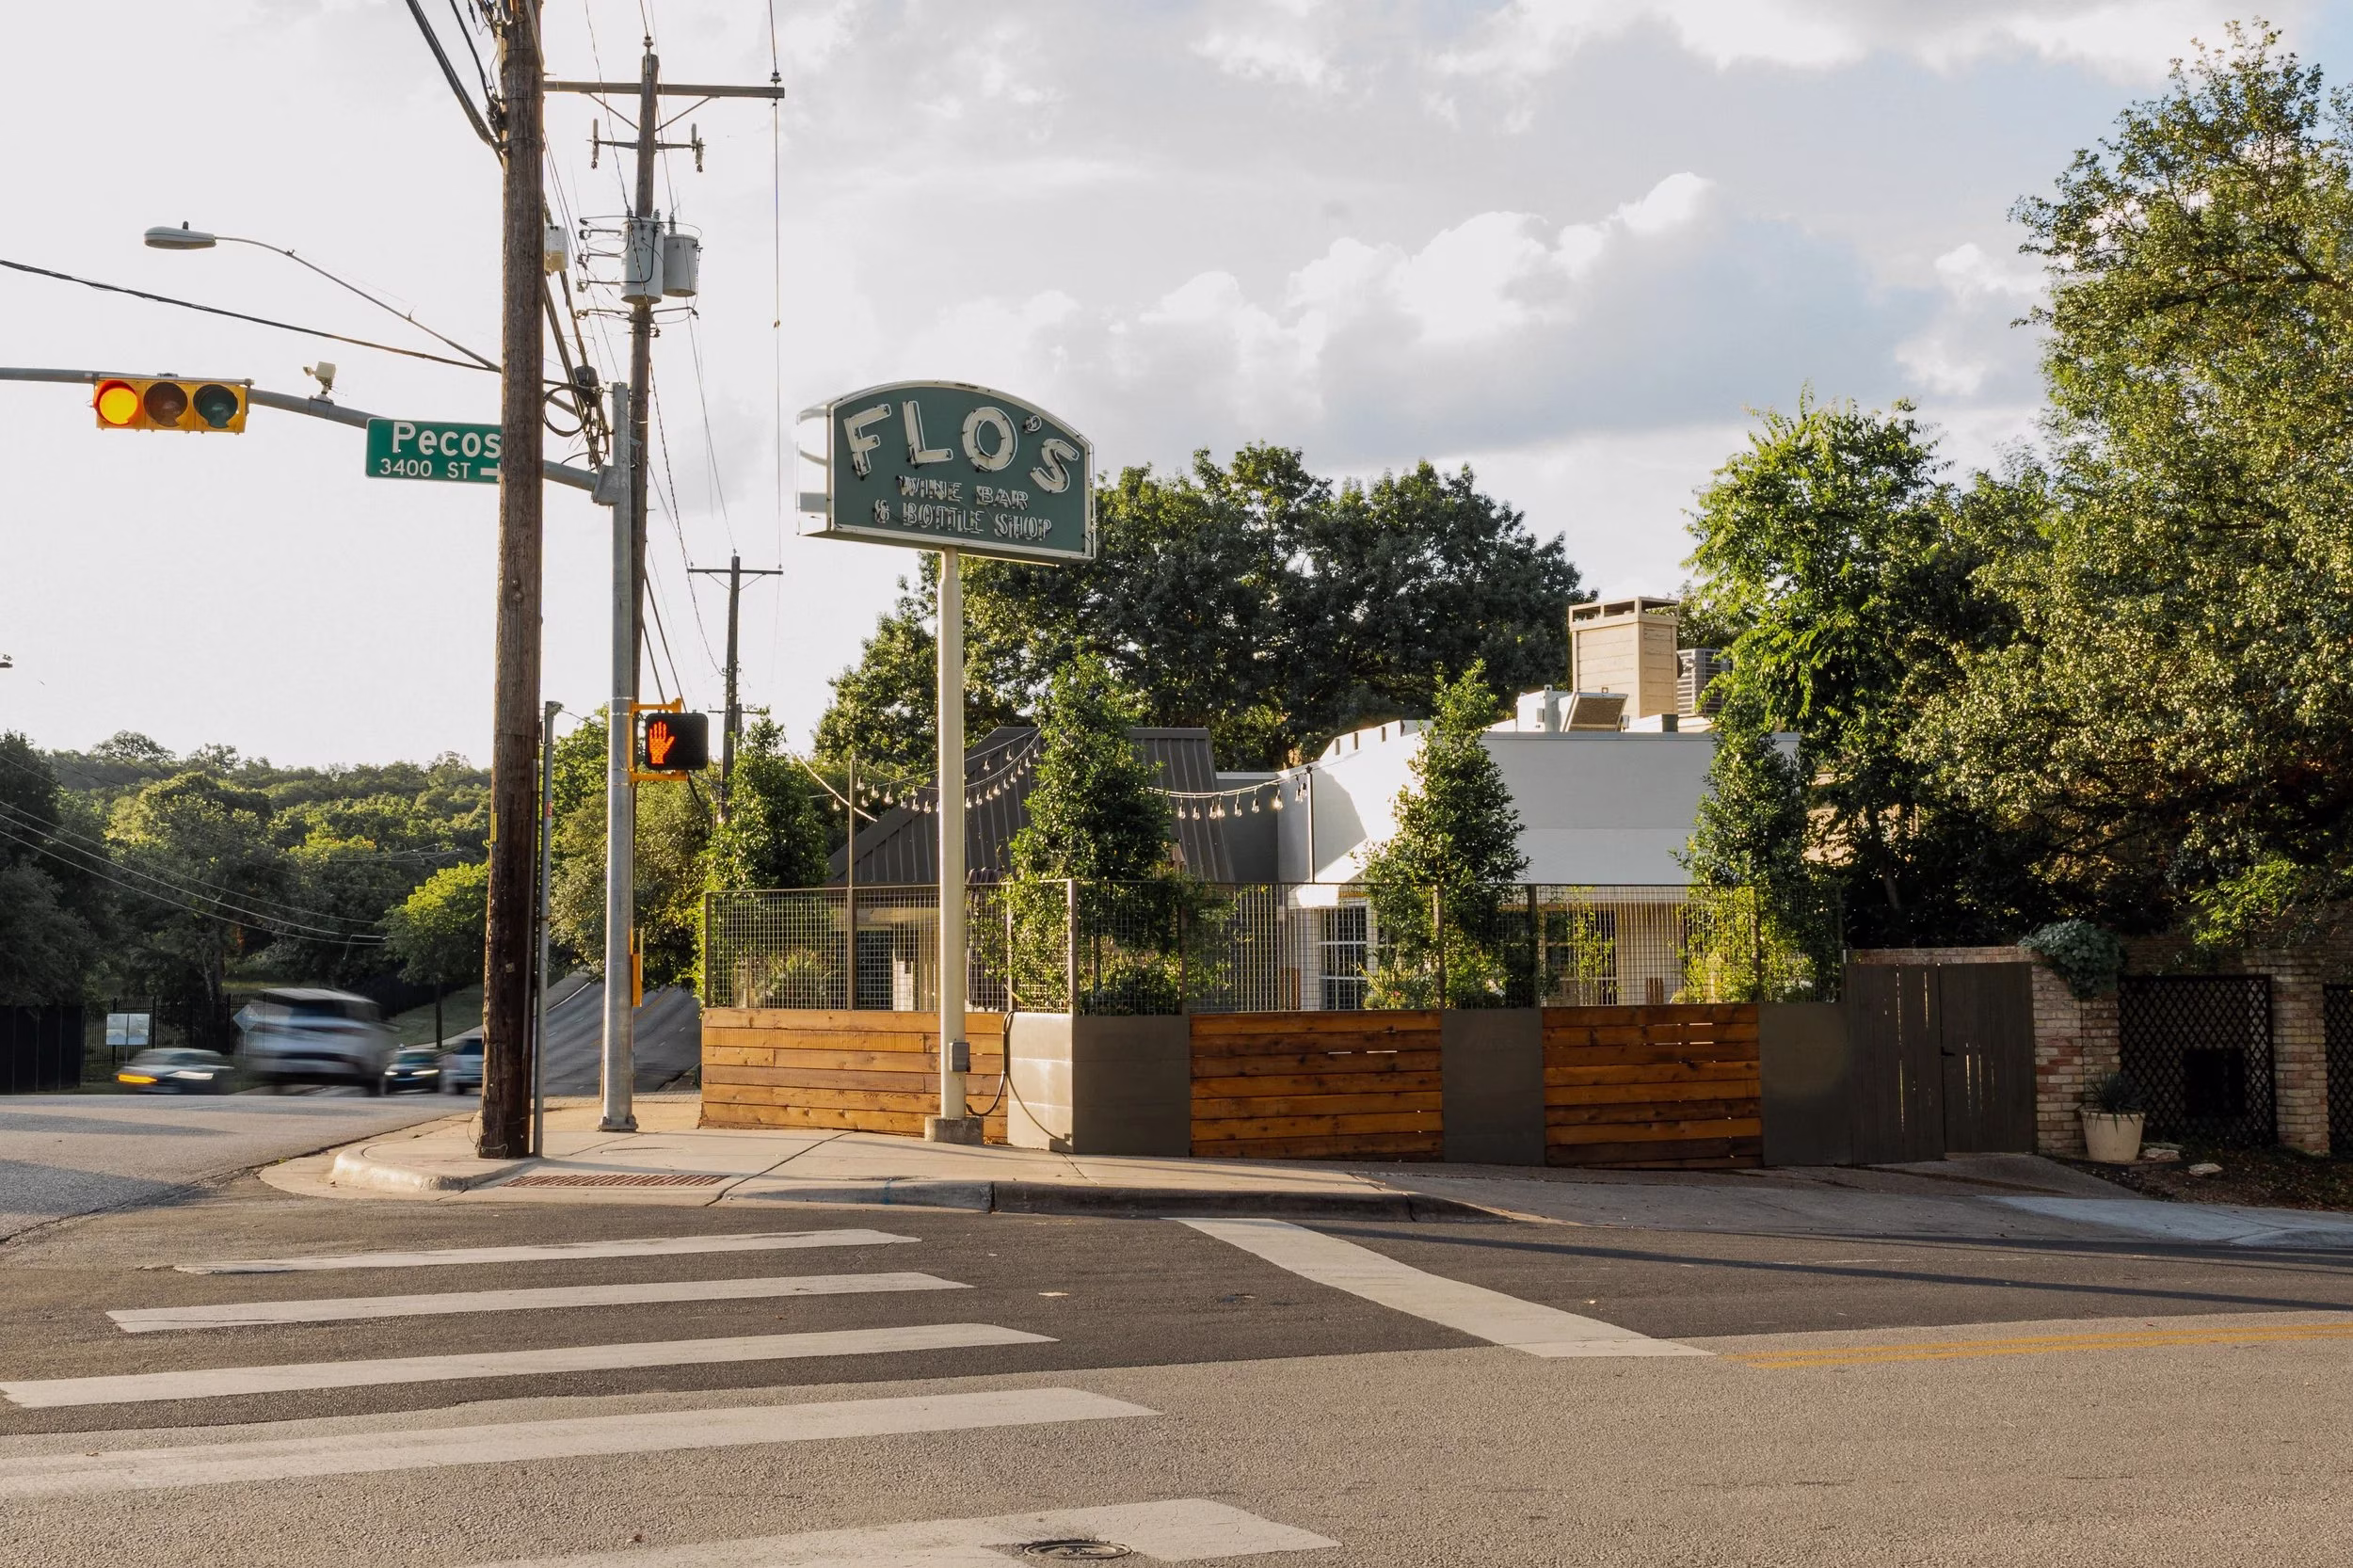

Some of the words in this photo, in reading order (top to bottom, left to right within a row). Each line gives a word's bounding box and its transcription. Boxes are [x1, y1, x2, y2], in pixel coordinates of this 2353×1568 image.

[392, 421, 502, 458] Pecos
[843, 400, 1080, 493] FLO'S
[379, 457, 433, 477] 3400
[447, 461, 472, 479] ST
[898, 475, 963, 502] WINE
[975, 485, 1029, 510] BAR
[873, 499, 890, 524] &
[903, 502, 984, 534] BOTTLE
[994, 513, 1052, 541] SHOP
